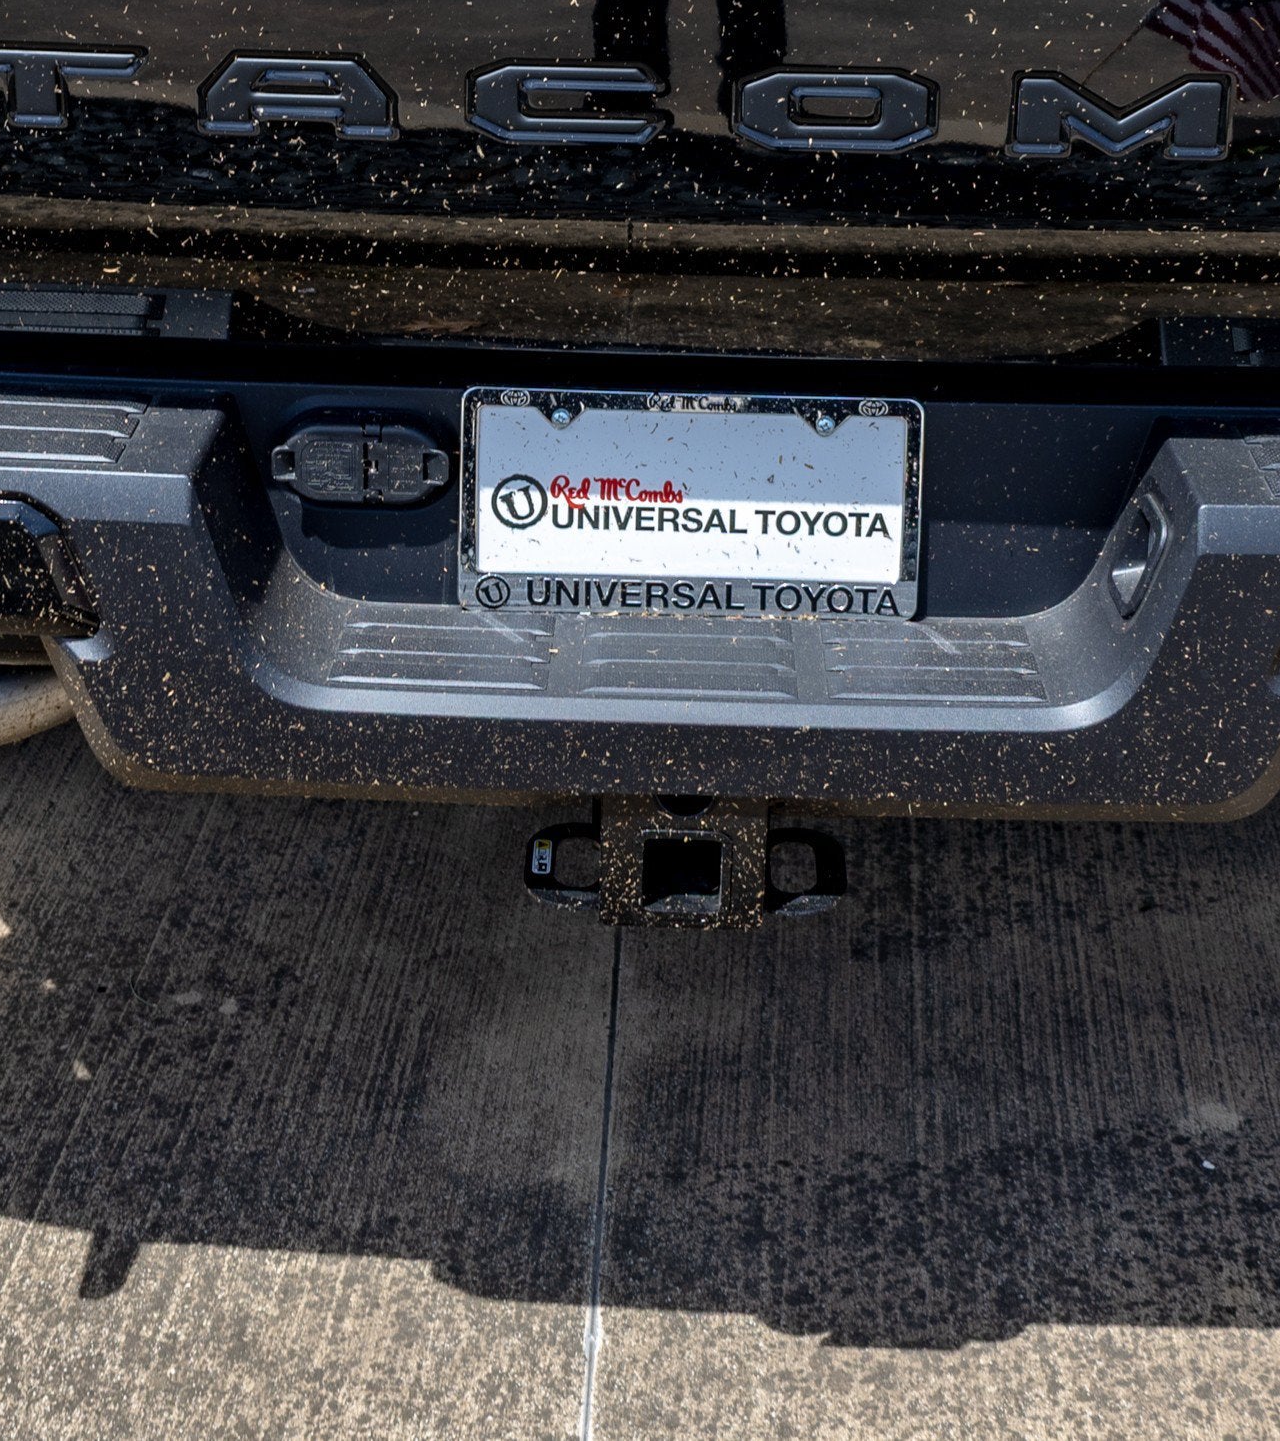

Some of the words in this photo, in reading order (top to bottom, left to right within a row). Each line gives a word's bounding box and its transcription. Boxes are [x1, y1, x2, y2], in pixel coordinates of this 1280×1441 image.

[550, 474, 590, 509] Red
[594, 476, 684, 504] McCombs
[551, 504, 747, 534] UNIVERSAL
[754, 509, 891, 539] TOYOTA
[526, 576, 746, 611] UNIVERSAL
[751, 581, 901, 616] TOYOTA
